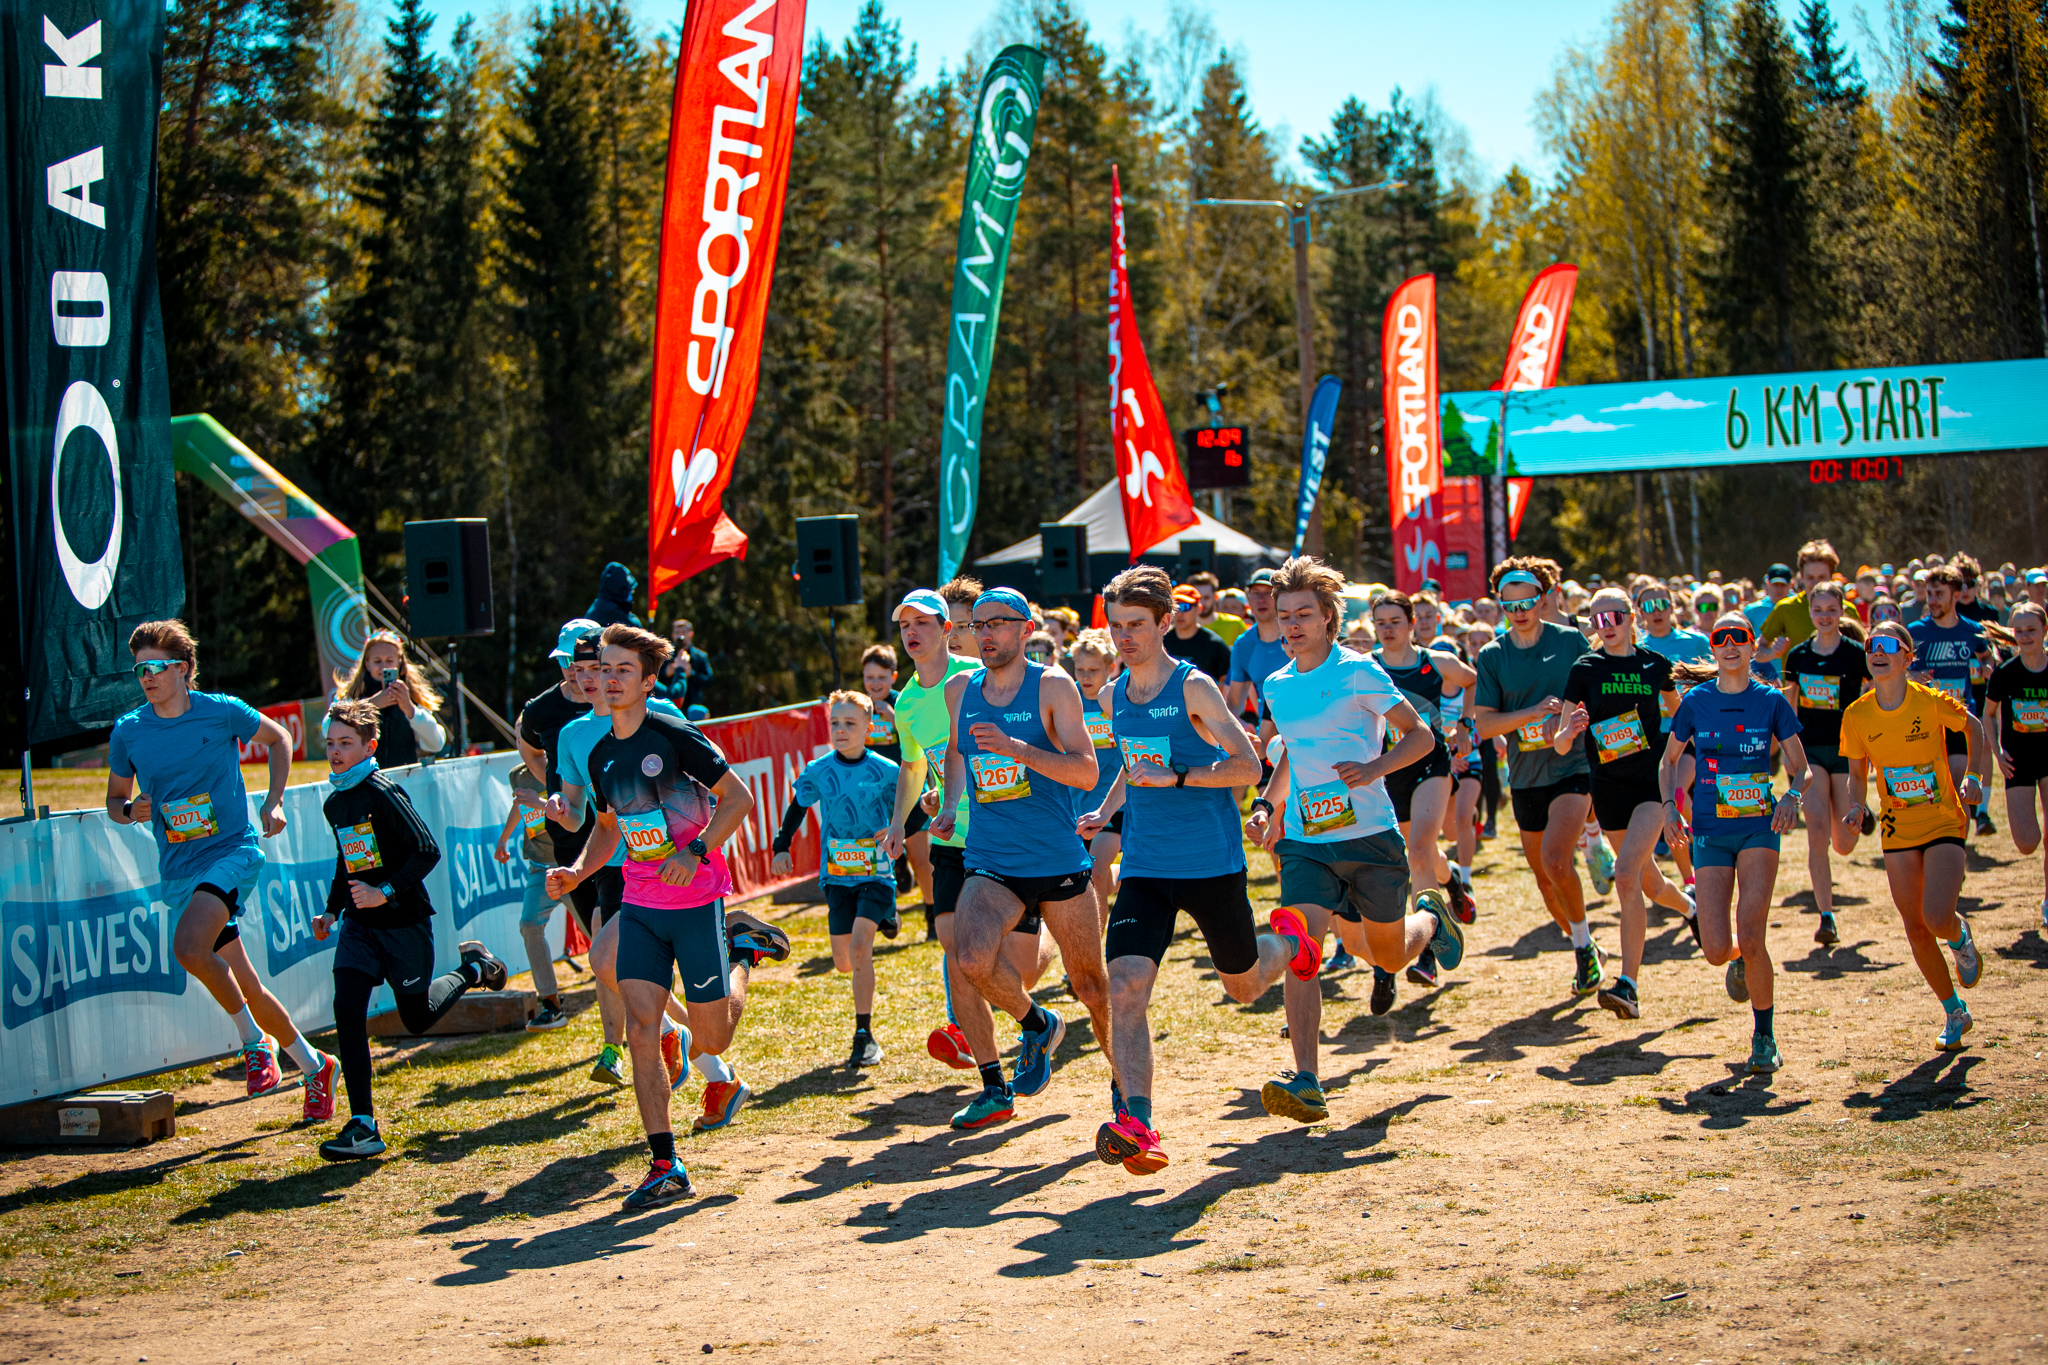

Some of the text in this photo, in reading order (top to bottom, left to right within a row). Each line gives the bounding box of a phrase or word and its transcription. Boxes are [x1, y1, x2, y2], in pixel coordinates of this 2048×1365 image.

[1726, 375, 1946, 450] 6 KM START
[1611, 672, 1641, 683] TLN
[1601, 682, 1652, 696] RNERS
[1806, 685, 1831, 697] 2123
[2023, 687, 2048, 698] TLN
[1003, 711, 1032, 723] sparta
[1148, 705, 1179, 720] sparta
[2020, 711, 2046, 721] 2082
[1602, 726, 1633, 746] 2069
[1739, 742, 1755, 755] ttp
[976, 766, 1019, 787] 1267
[1893, 779, 1927, 793] 2034
[1727, 787, 1761, 801] 2030
[1304, 796, 1345, 821] 1225
[170, 810, 202, 828] 2071
[625, 828, 664, 848] 1000
[342, 840, 367, 856] 2080
[835, 851, 866, 862] 2038
[10, 900, 172, 1008] SALVEST
